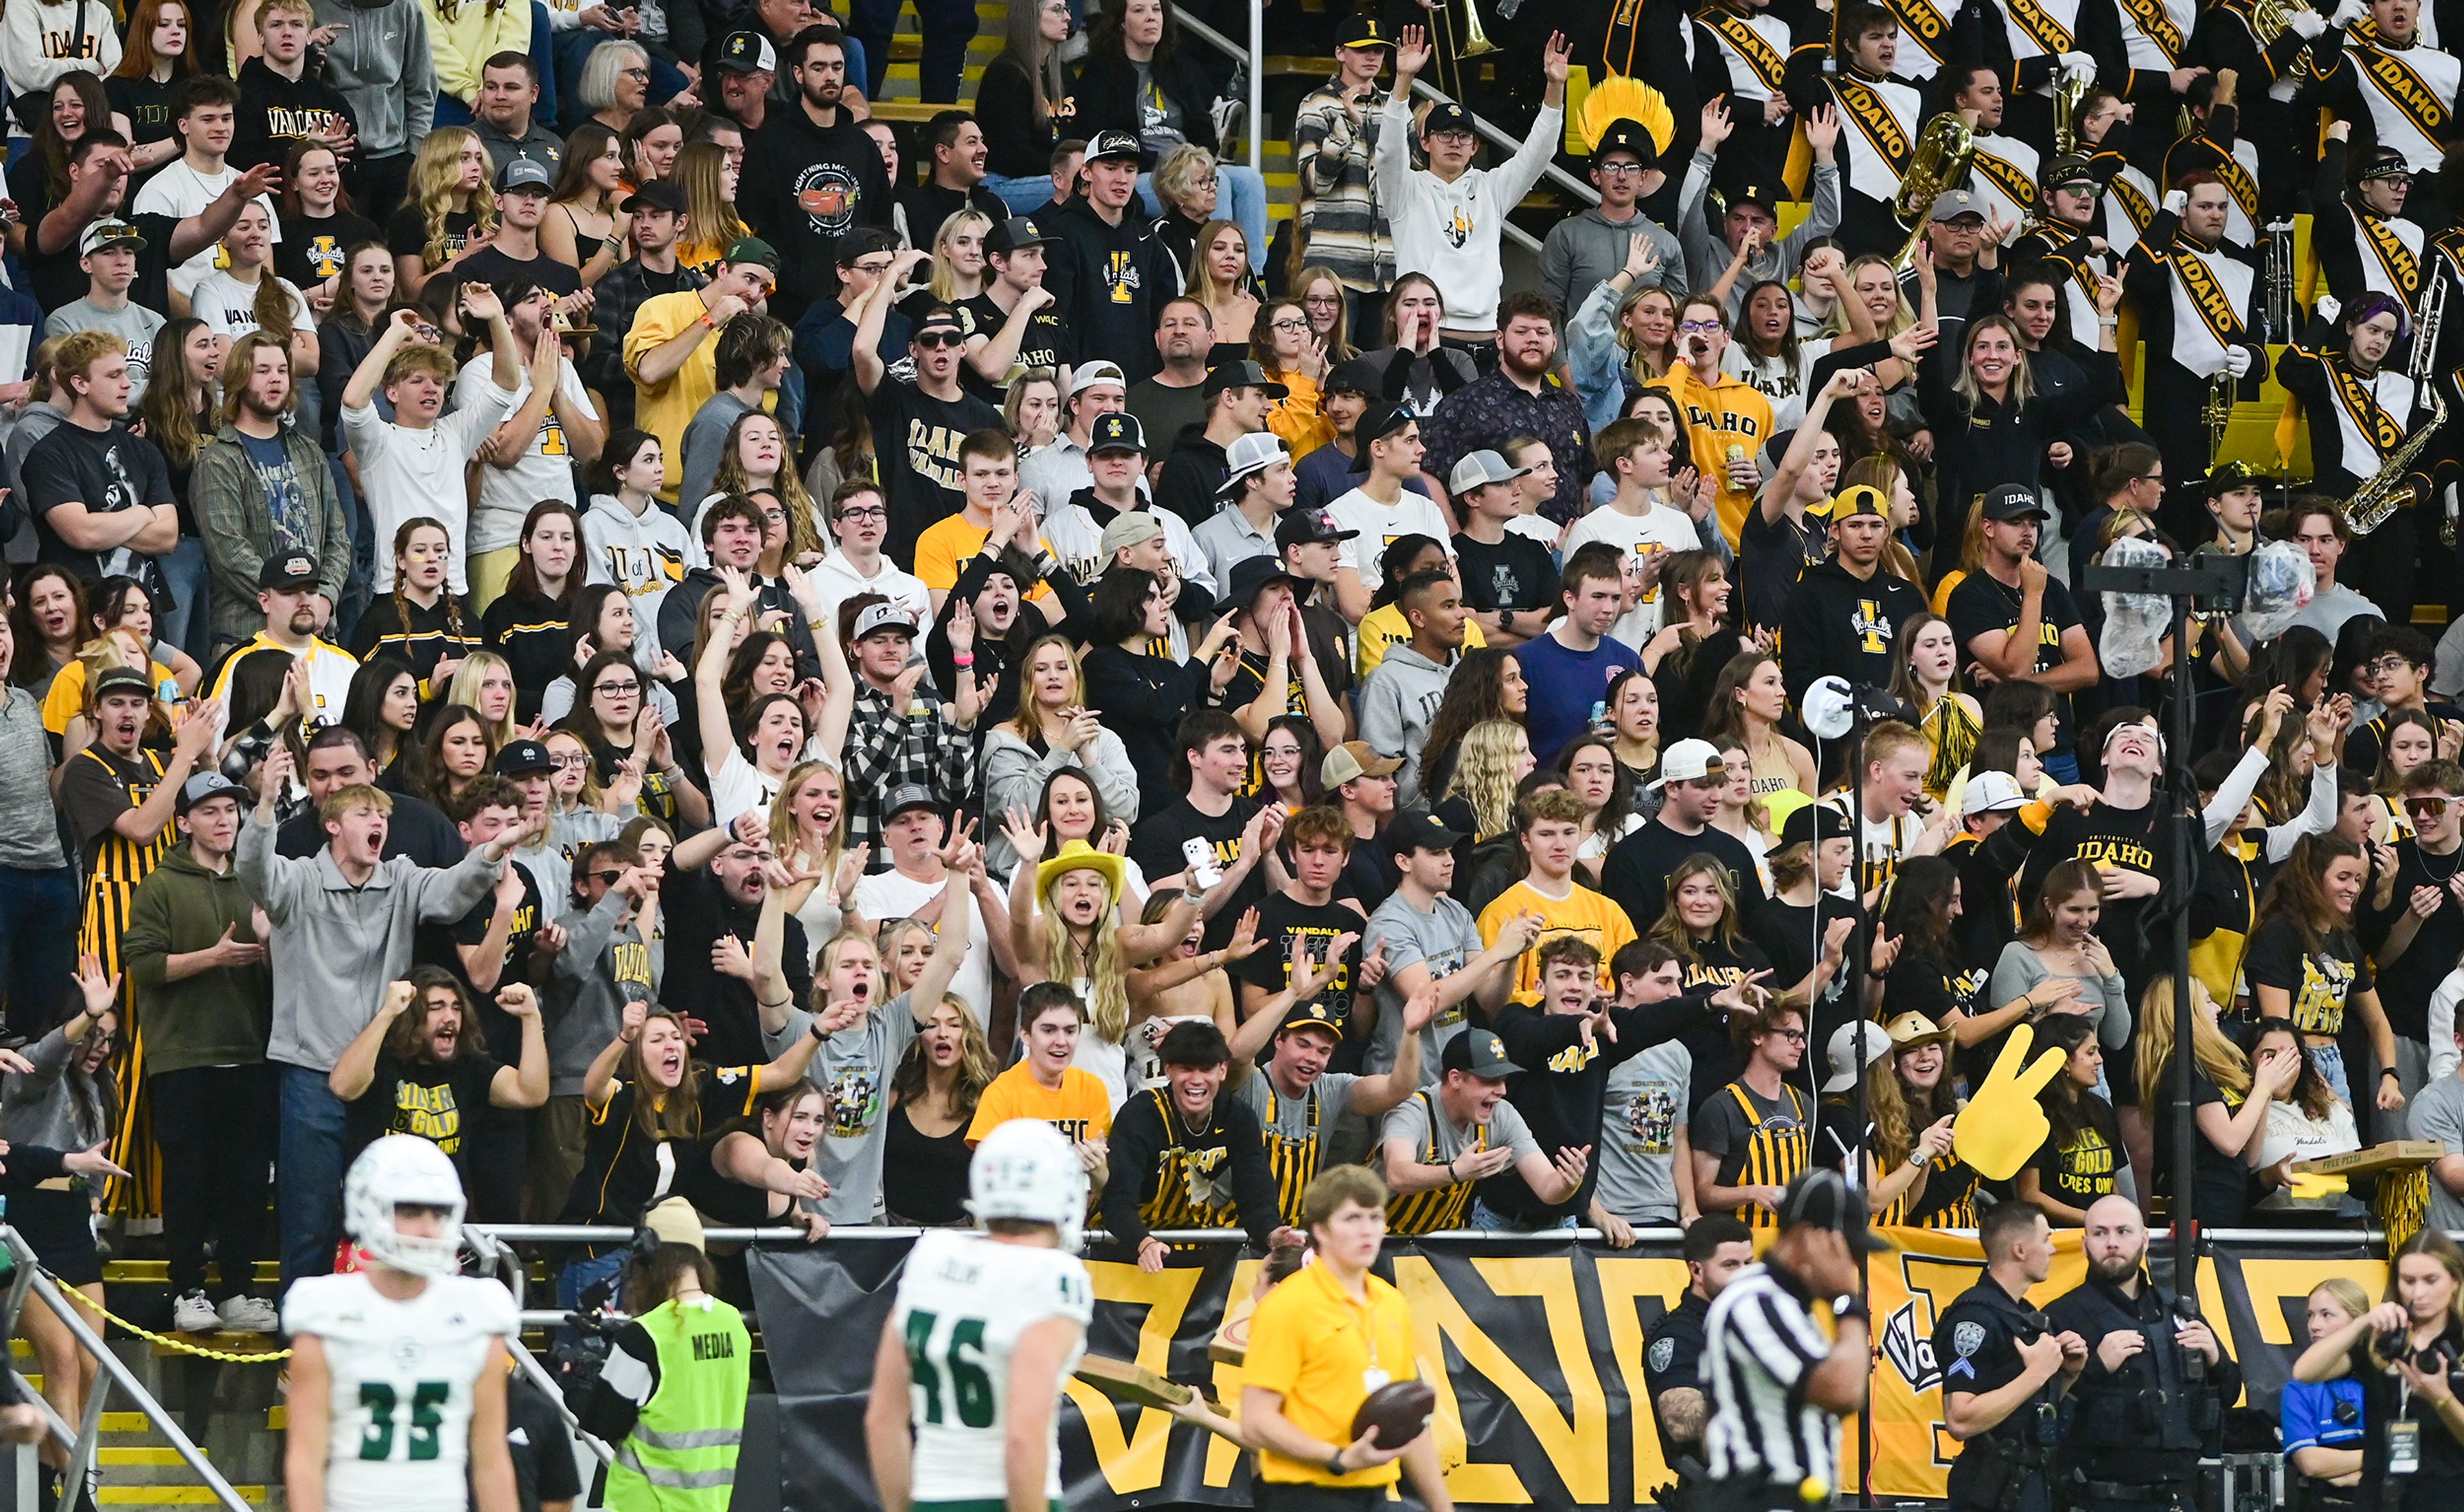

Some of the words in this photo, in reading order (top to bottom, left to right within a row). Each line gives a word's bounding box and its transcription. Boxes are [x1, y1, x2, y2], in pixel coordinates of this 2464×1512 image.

[1720, 17, 1786, 85] IDAHO
[2371, 58, 2440, 126] IDAHO
[1842, 85, 1904, 159] IDAHO
[2177, 252, 2231, 333] IDAHO
[2004, 494, 2035, 504] IDAHO
[632, 560, 642, 576] of
[2077, 841, 2153, 869] IDAHO
[1285, 927, 1341, 936] VANDALS
[397, 1080, 454, 1112] SILVER
[411, 1108, 459, 1137] GOLD
[2075, 1150, 2112, 1173] GOLD
[2322, 1158, 2340, 1169] FREE
[2341, 1154, 2362, 1167] PIZZA
[691, 1332, 734, 1361] MEDIA
[358, 1381, 448, 1461] 35
